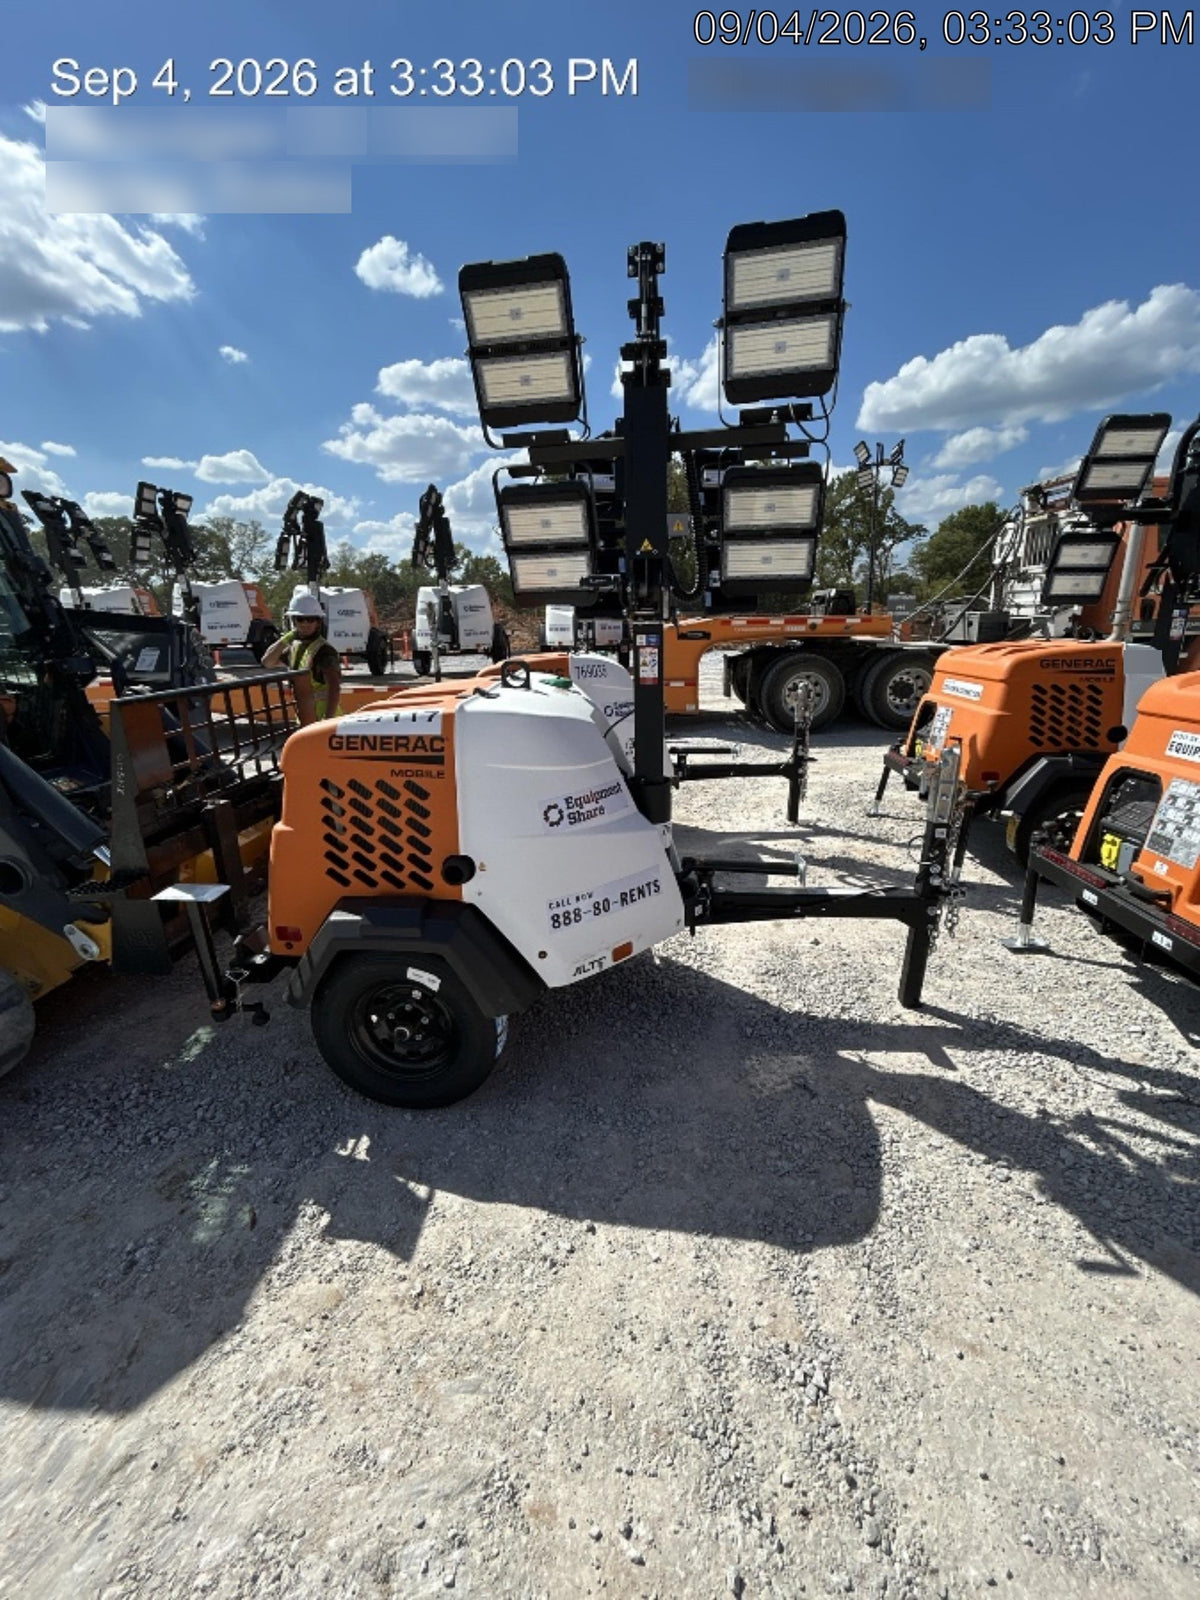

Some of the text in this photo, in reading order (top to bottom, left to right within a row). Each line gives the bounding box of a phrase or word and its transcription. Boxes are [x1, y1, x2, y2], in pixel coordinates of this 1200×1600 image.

[1040, 658, 1115, 669] GENERAC
[328, 734, 445, 753] GENERAC
[390, 768, 445, 779] MOBILE
[564, 782, 623, 810] Equipment
[567, 805, 605, 825] Share
[548, 898, 572, 911] CALL
[551, 879, 661, 929] 888-80-RENTS
